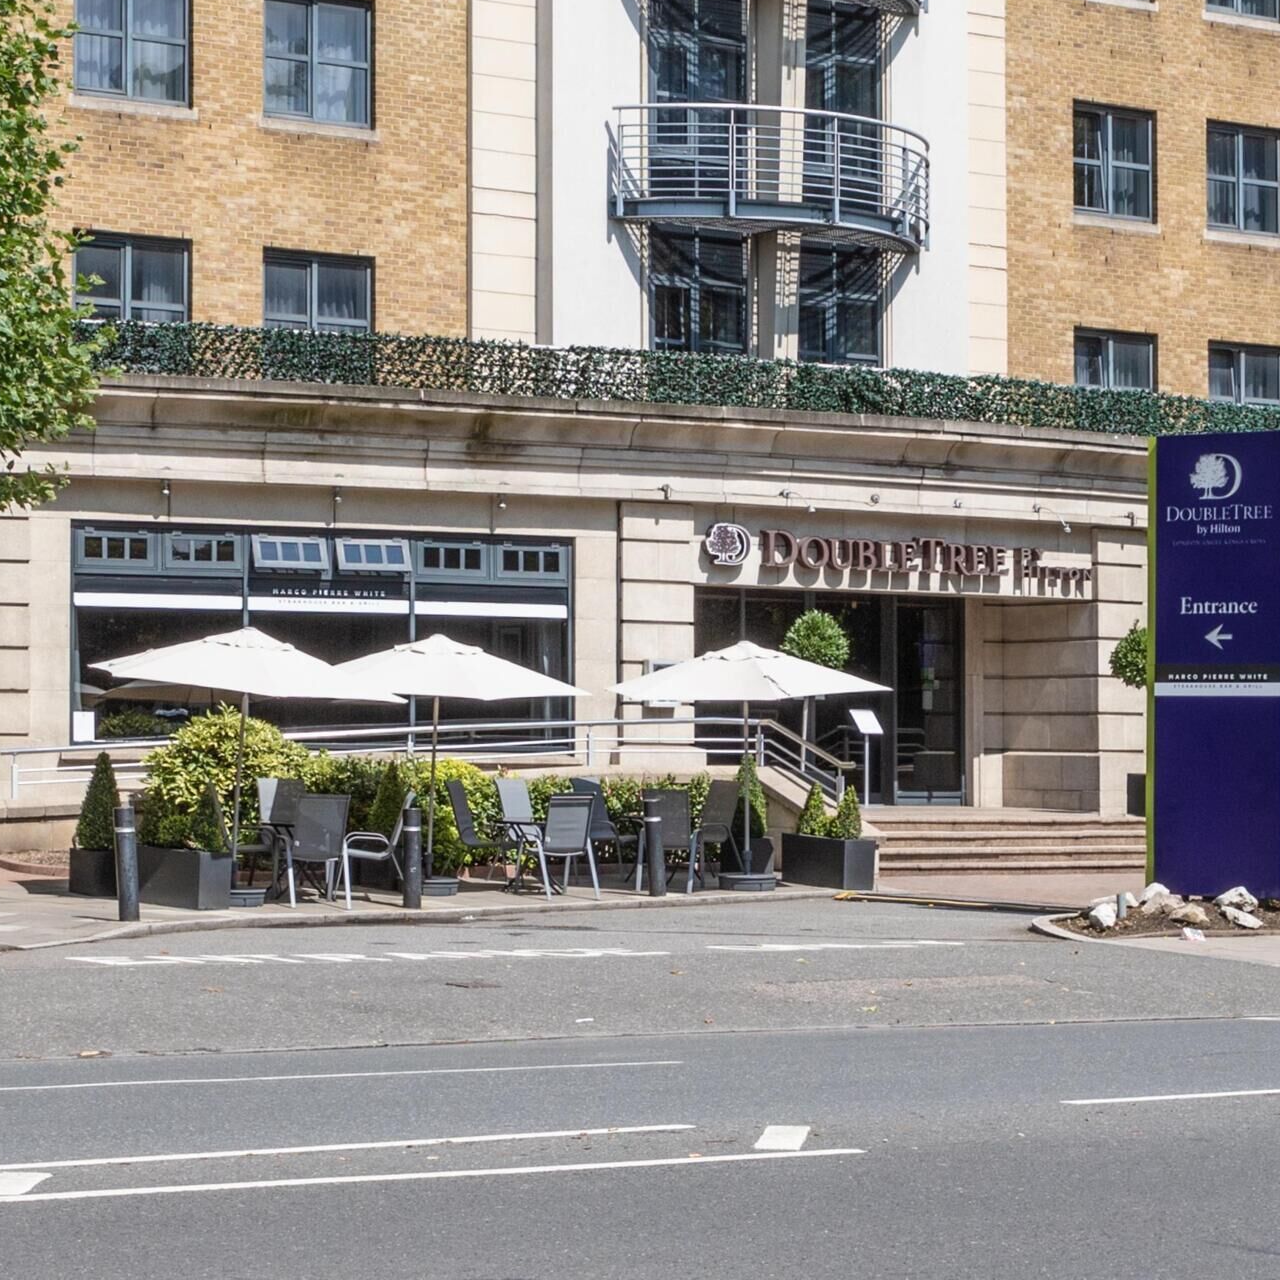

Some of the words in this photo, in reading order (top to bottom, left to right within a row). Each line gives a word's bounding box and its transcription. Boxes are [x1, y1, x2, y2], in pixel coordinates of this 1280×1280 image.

[1166, 504, 1272, 522] DOUBLETREE
[1196, 524, 1208, 536] by
[1210, 524, 1241, 534] Hilton
[760, 530, 1009, 576] DOUBLETREE
[1020, 547, 1045, 562] BY
[1022, 564, 1093, 581] HILTON
[1180, 596, 1259, 615] Entrance
